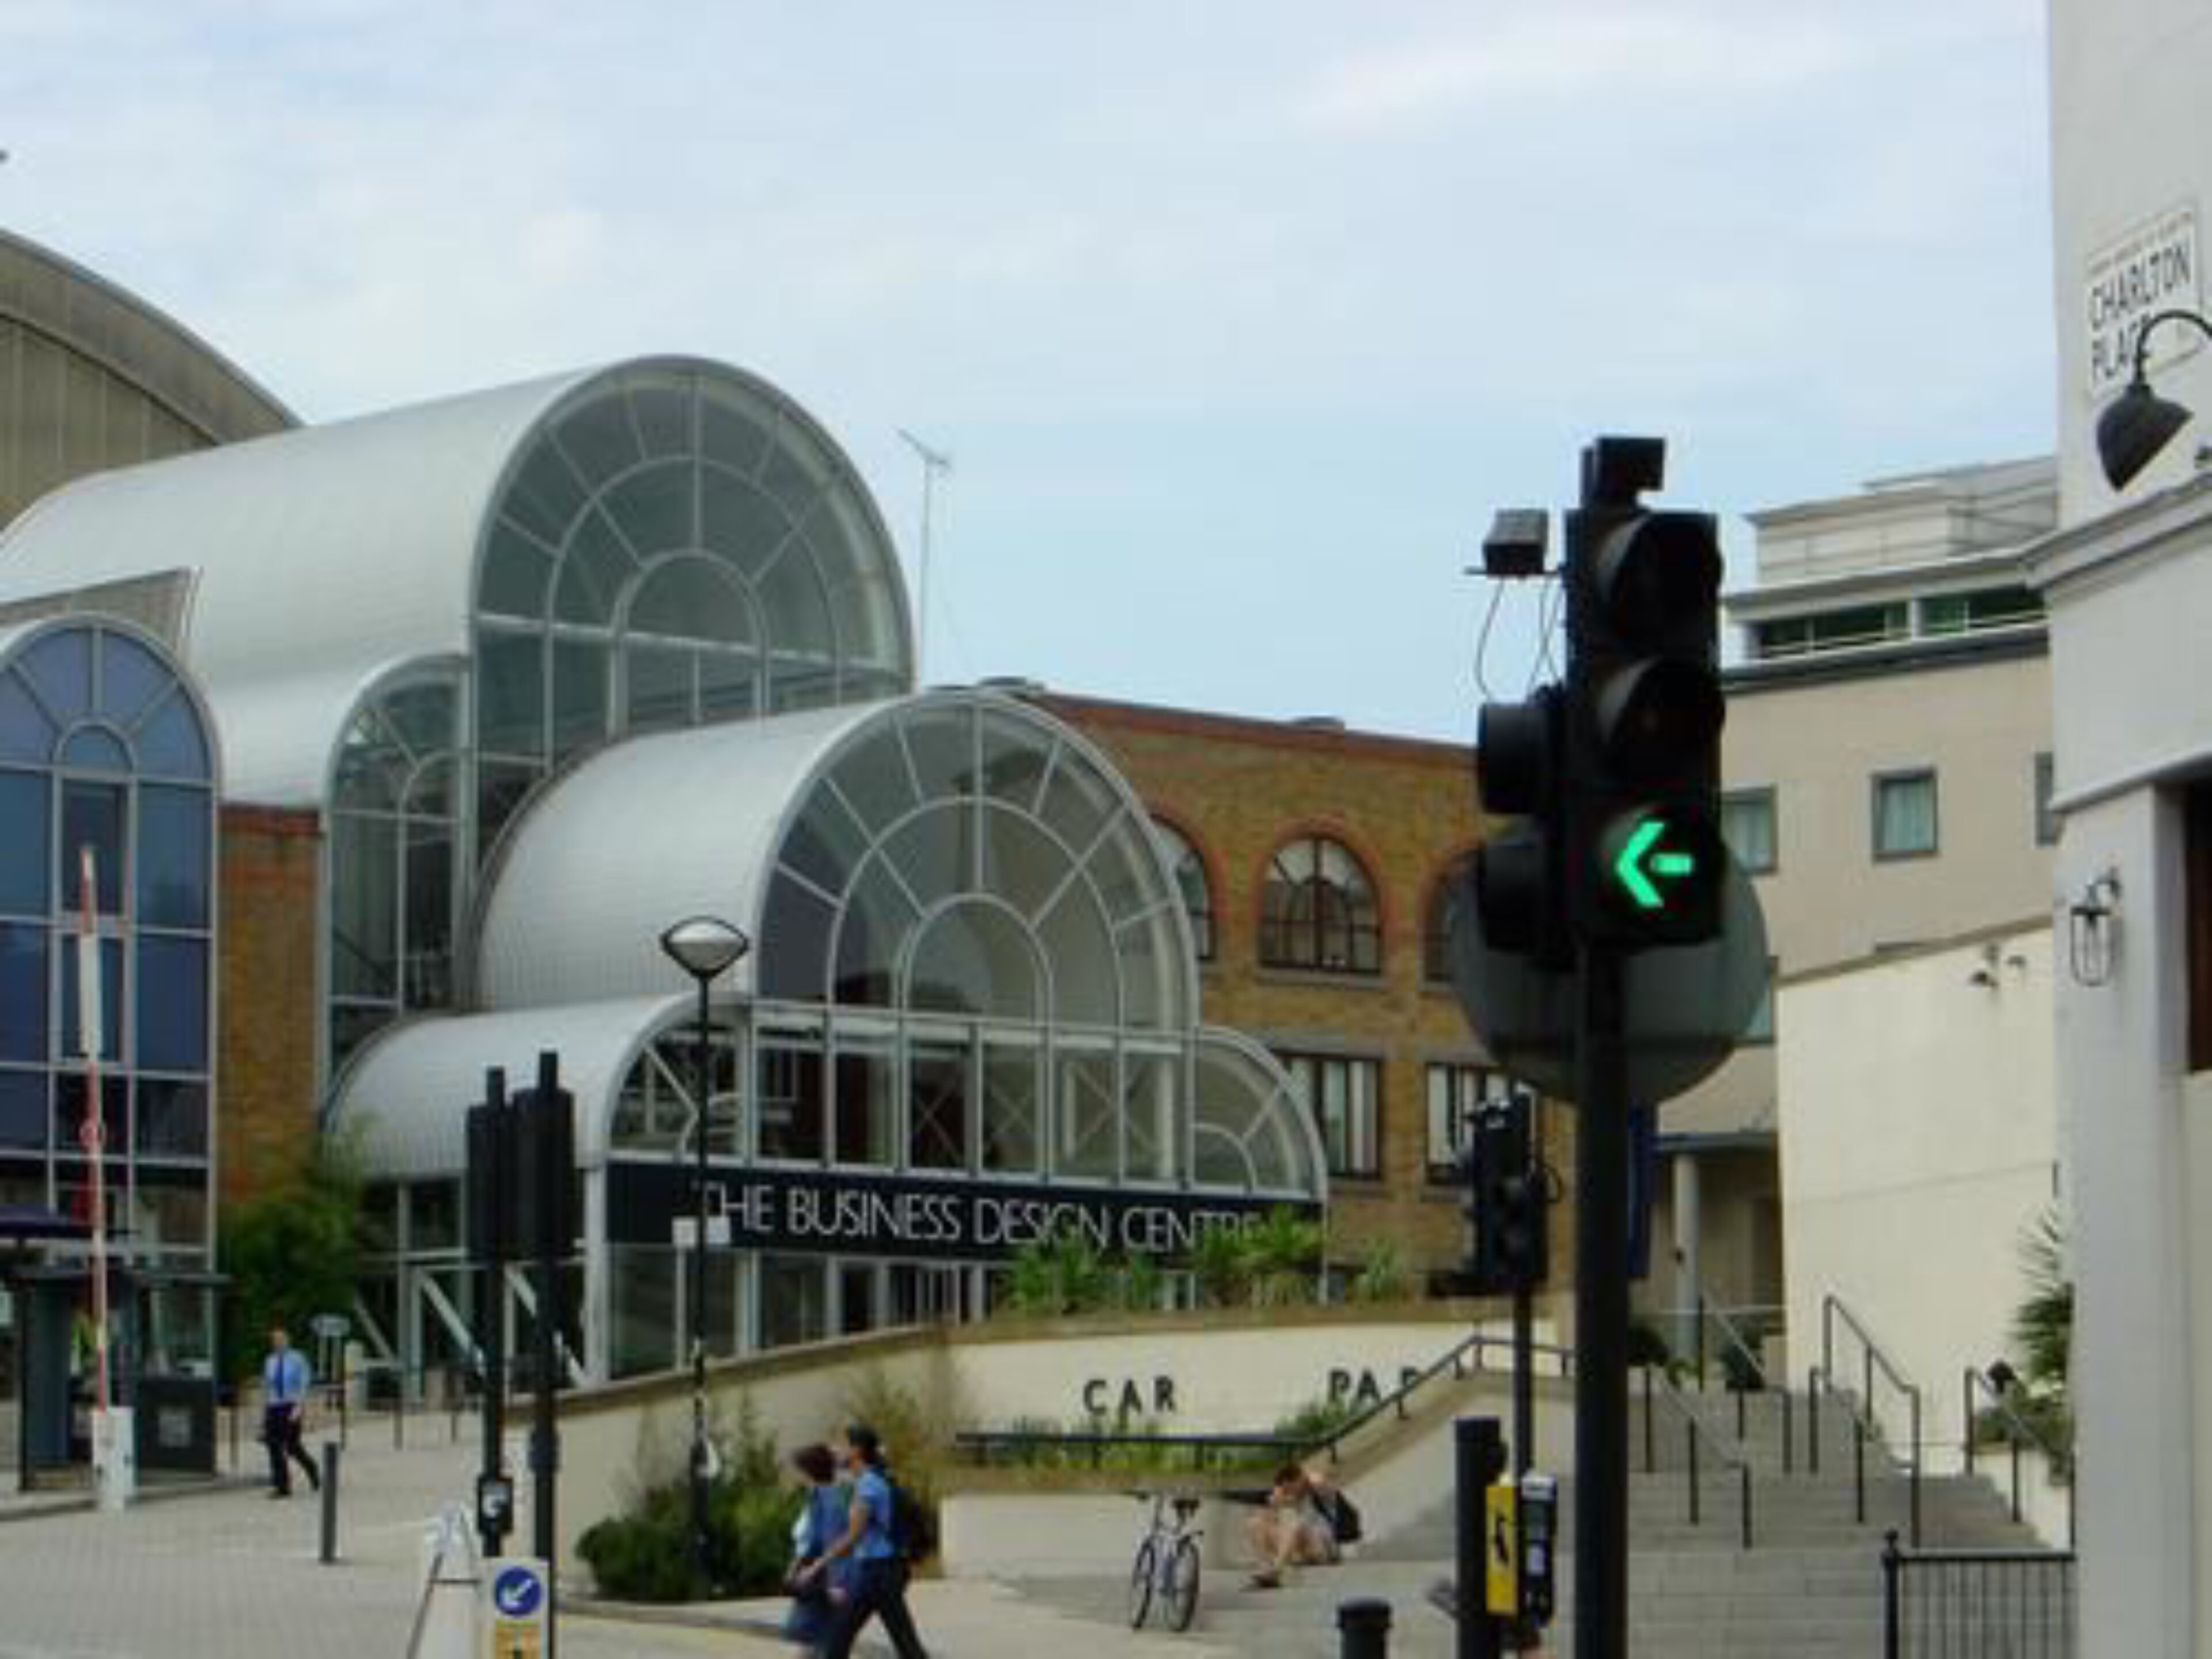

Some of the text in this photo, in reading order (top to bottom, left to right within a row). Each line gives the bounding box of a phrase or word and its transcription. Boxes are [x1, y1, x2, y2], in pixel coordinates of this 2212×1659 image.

[2090, 243, 2191, 331] CHARLTON
[787, 1187, 960, 1240] BUSINESS
[973, 1198, 1110, 1250] DESIGN
[1084, 1376, 1176, 1415] CAR
